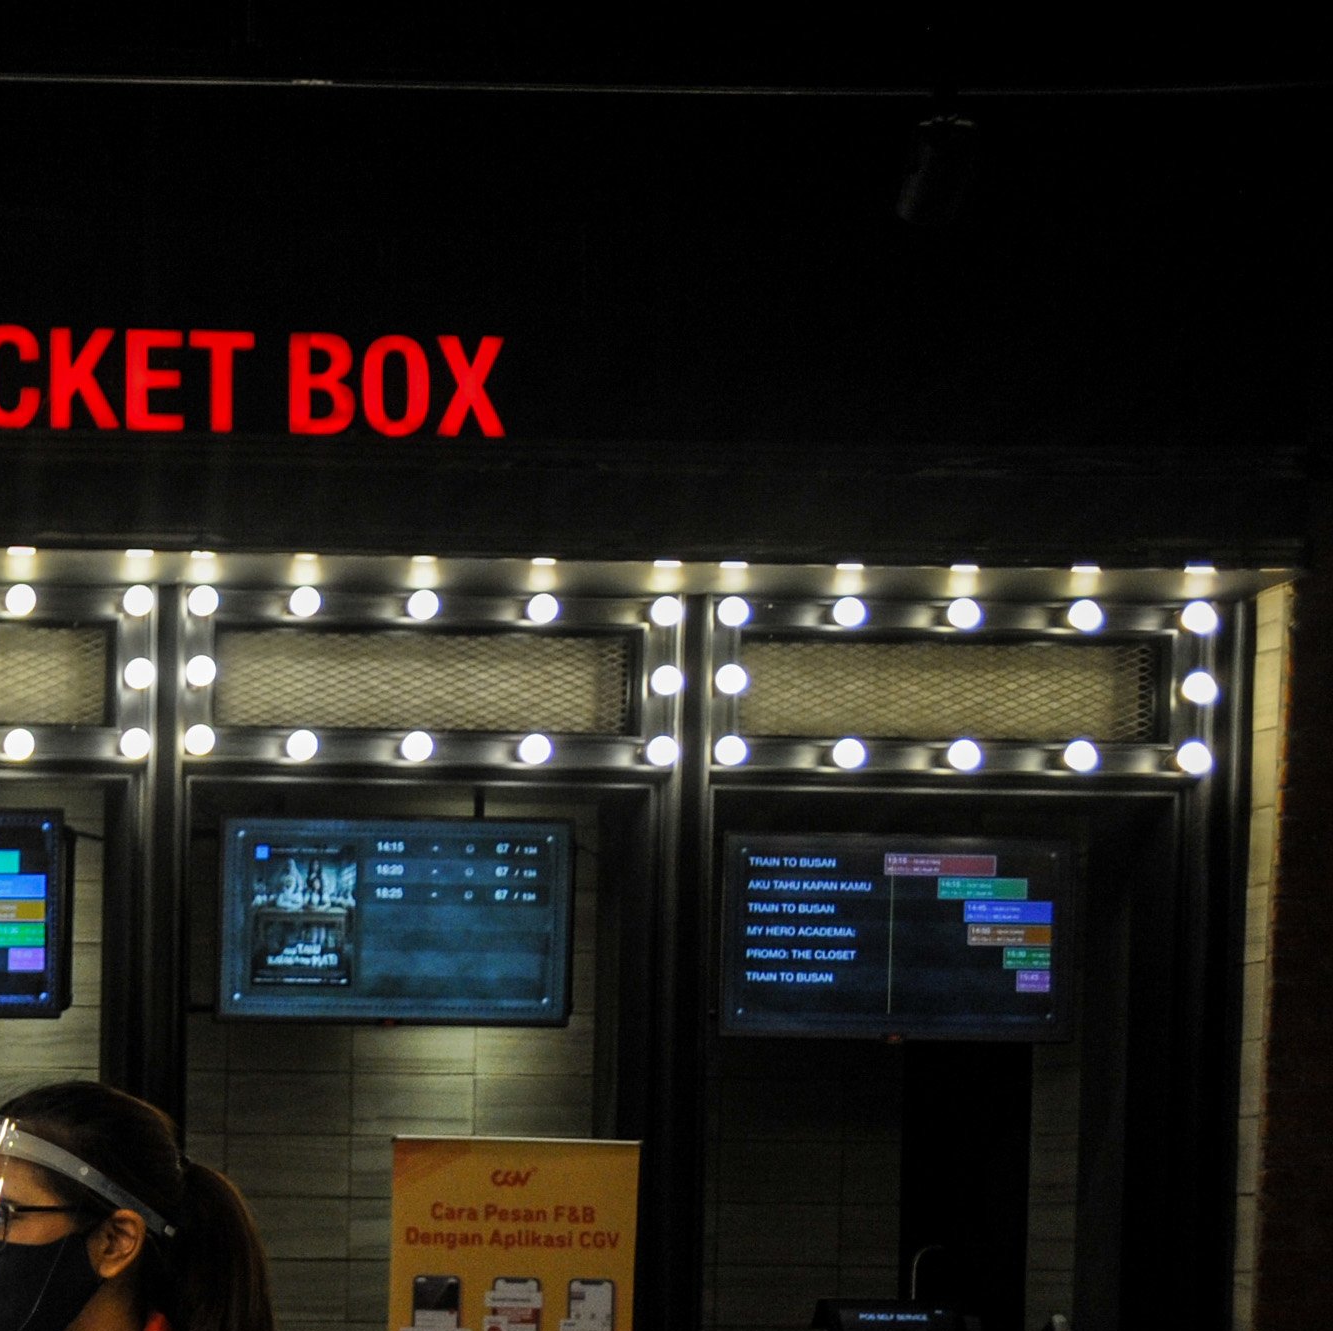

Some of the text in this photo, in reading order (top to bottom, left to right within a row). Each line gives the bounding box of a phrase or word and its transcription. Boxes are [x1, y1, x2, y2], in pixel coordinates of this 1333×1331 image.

[288, 332, 505, 437] BOX
[749, 856, 836, 869] TRAIN TO BUSAN
[748, 880, 872, 892] AKU TAHU KAPAN KAMU
[748, 903, 835, 914] TRAIN TO BUSAN
[746, 926, 856, 938] MY HERO ACADEMIA:
[746, 948, 857, 960] PROMO: THE CLOSET
[746, 971, 833, 982] TRAIN TO BUSAN
[490, 1167, 534, 1187] CGV
[431, 1201, 595, 1224] Cara Pesan F&B
[405, 1226, 620, 1251] Dengan Aplikasi CGV
